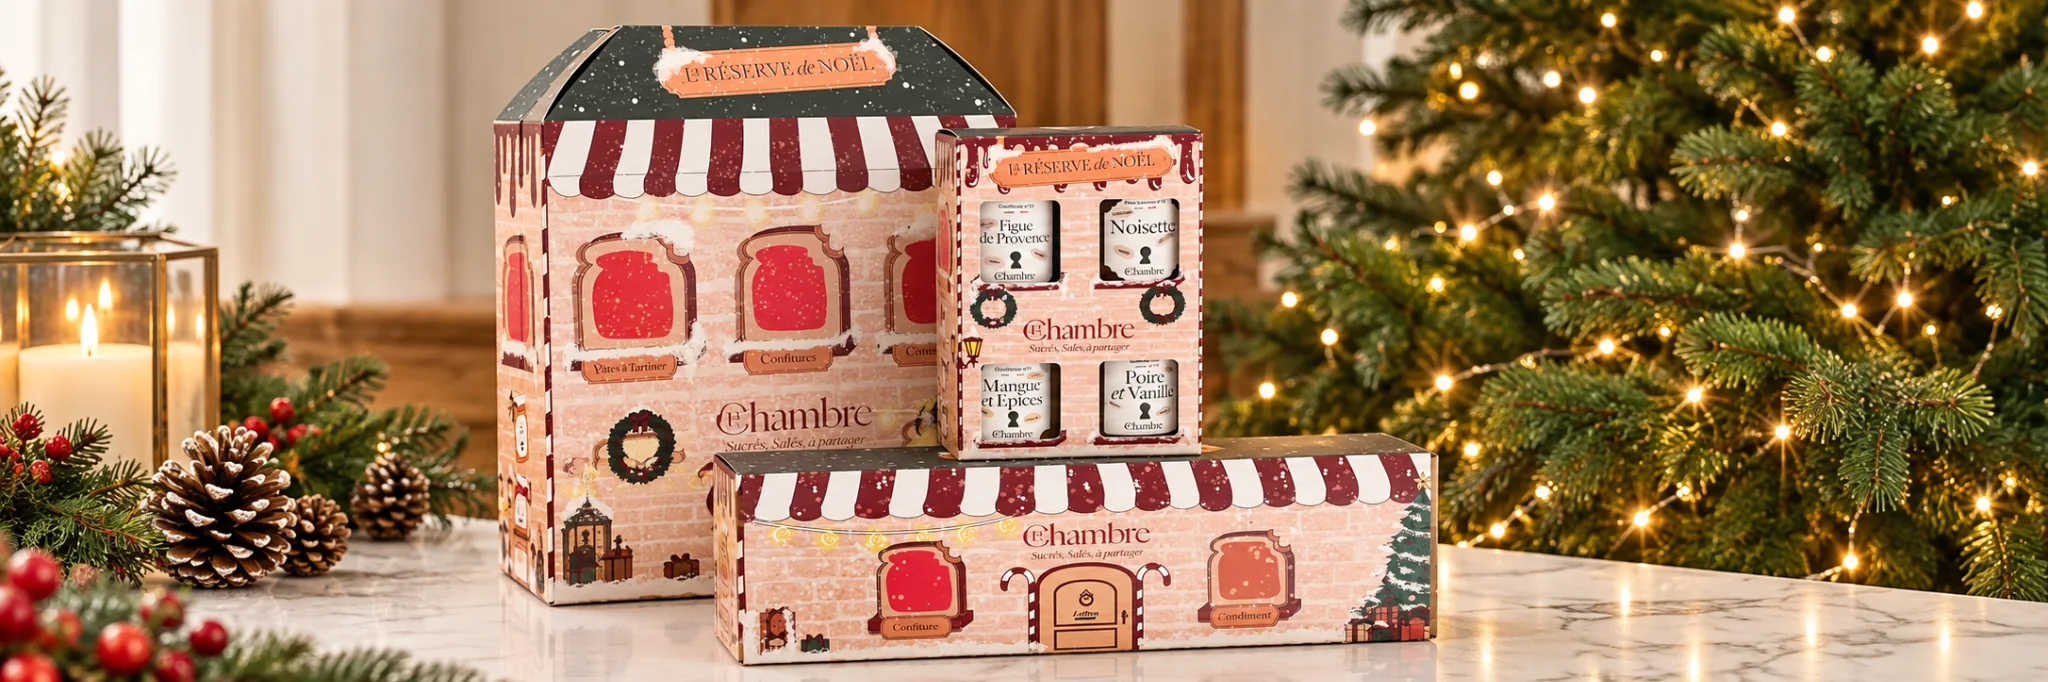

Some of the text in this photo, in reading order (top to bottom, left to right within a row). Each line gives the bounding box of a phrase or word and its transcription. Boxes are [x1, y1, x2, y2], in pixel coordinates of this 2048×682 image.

[703, 61, 794, 81] RÉSERVE
[797, 59, 815, 75] de
[817, 53, 875, 73] NOËL
[1023, 157, 1092, 175] RÉSERVE
[1094, 157, 1110, 171] de
[1112, 151, 1155, 169] NOËL
[999, 219, 1034, 235] Figue
[1110, 219, 1176, 235] Noisette
[980, 232, 1050, 244] de Provence
[760, 353, 817, 364] Confitures
[593, 363, 620, 375] Pâtes
[628, 361, 667, 372] Tartiner
[1126, 370, 1165, 384] Poire
[983, 379, 1042, 396] Mangue
[1111, 385, 1174, 400] et Vanille
[981, 394, 1043, 410] et Epices
[808, 436, 815, 448] à
[816, 436, 866, 450] partager
[1102, 549, 1144, 560] partager
[1217, 612, 1272, 621] Condiment
[892, 622, 939, 631] Confiture
